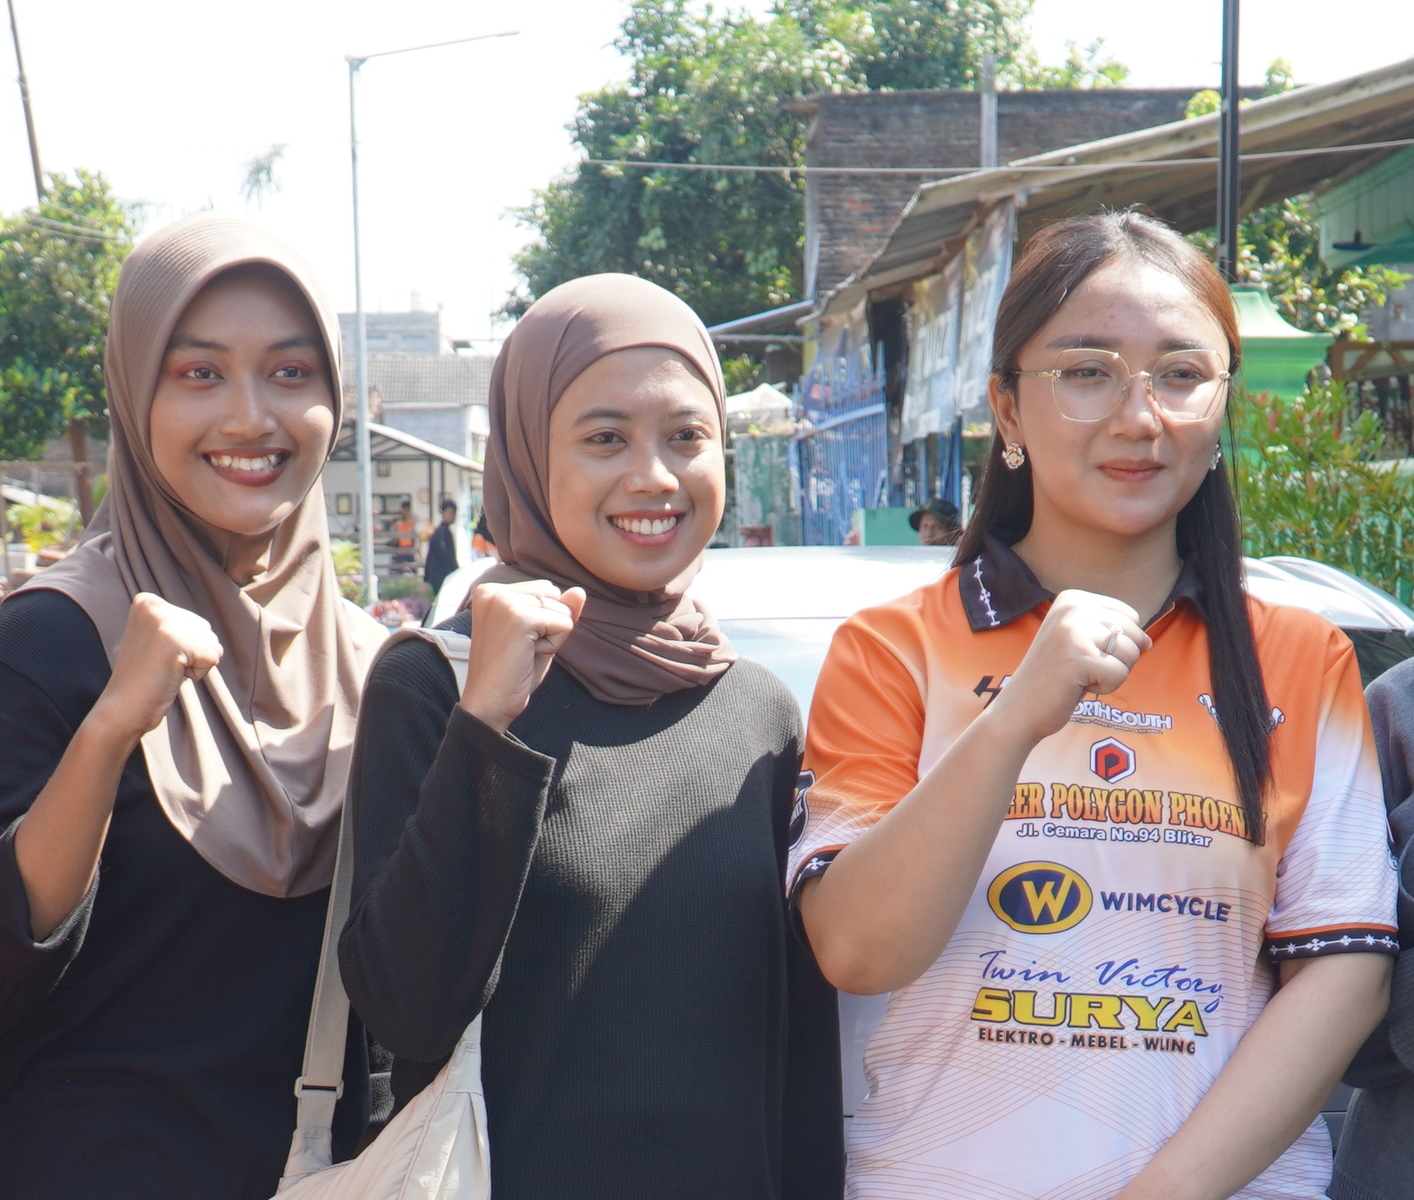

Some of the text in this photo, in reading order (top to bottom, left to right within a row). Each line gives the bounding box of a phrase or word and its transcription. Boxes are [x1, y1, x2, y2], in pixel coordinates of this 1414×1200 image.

[1017, 822, 1213, 848] Jl. Cemara No.94 Blitar
[1050, 782, 1164, 826] POLYGON
[1168, 791, 1268, 846] PHOEN
[1099, 890, 1233, 923] WIMCYCLE
[979, 949, 1225, 1014] Twin Victory
[970, 986, 1209, 1037] SURYA
[978, 1026, 1055, 1047] ELEKTRO
[1070, 1033, 1128, 1050] MEBEL
